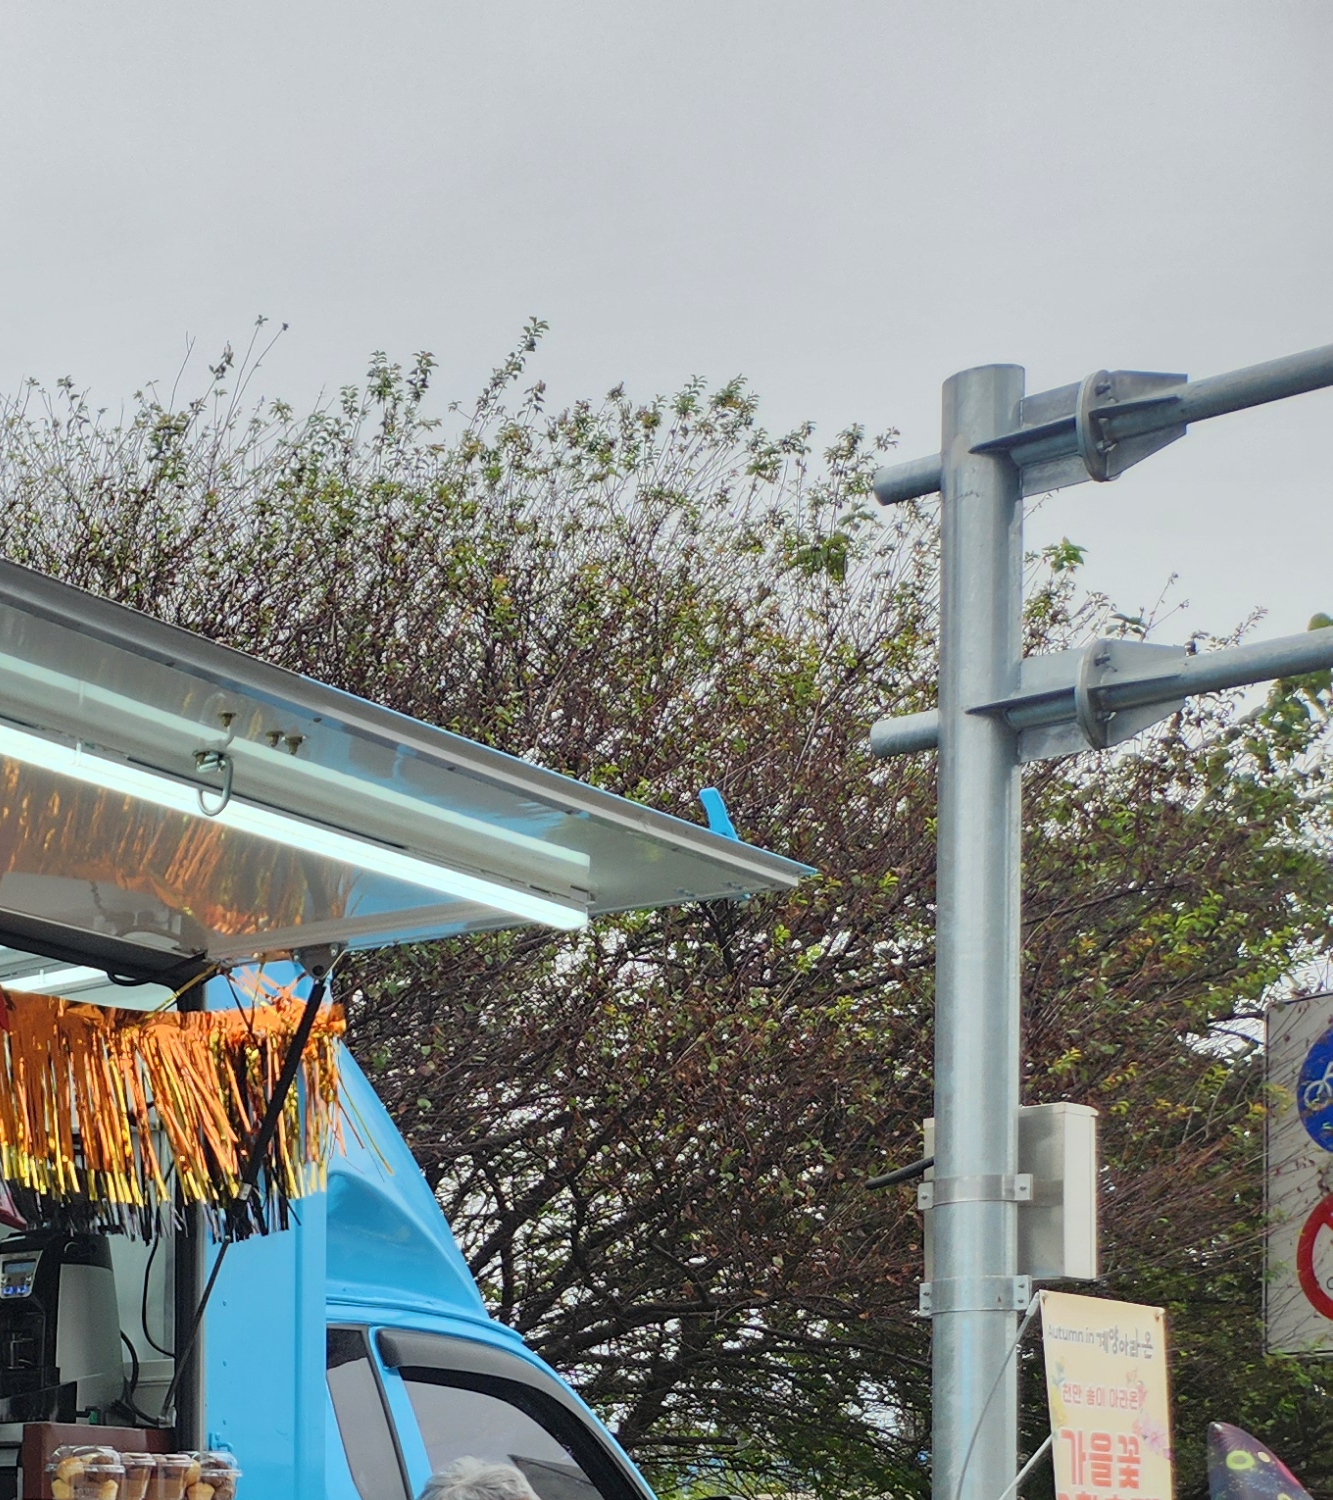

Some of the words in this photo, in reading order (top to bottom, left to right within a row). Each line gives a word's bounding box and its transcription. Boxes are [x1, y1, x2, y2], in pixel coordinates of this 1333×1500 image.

[1048, 1325, 1084, 1344] Autumn
[1085, 1326, 1095, 1344] in
[1060, 1429, 1141, 1490] 가을꽃
